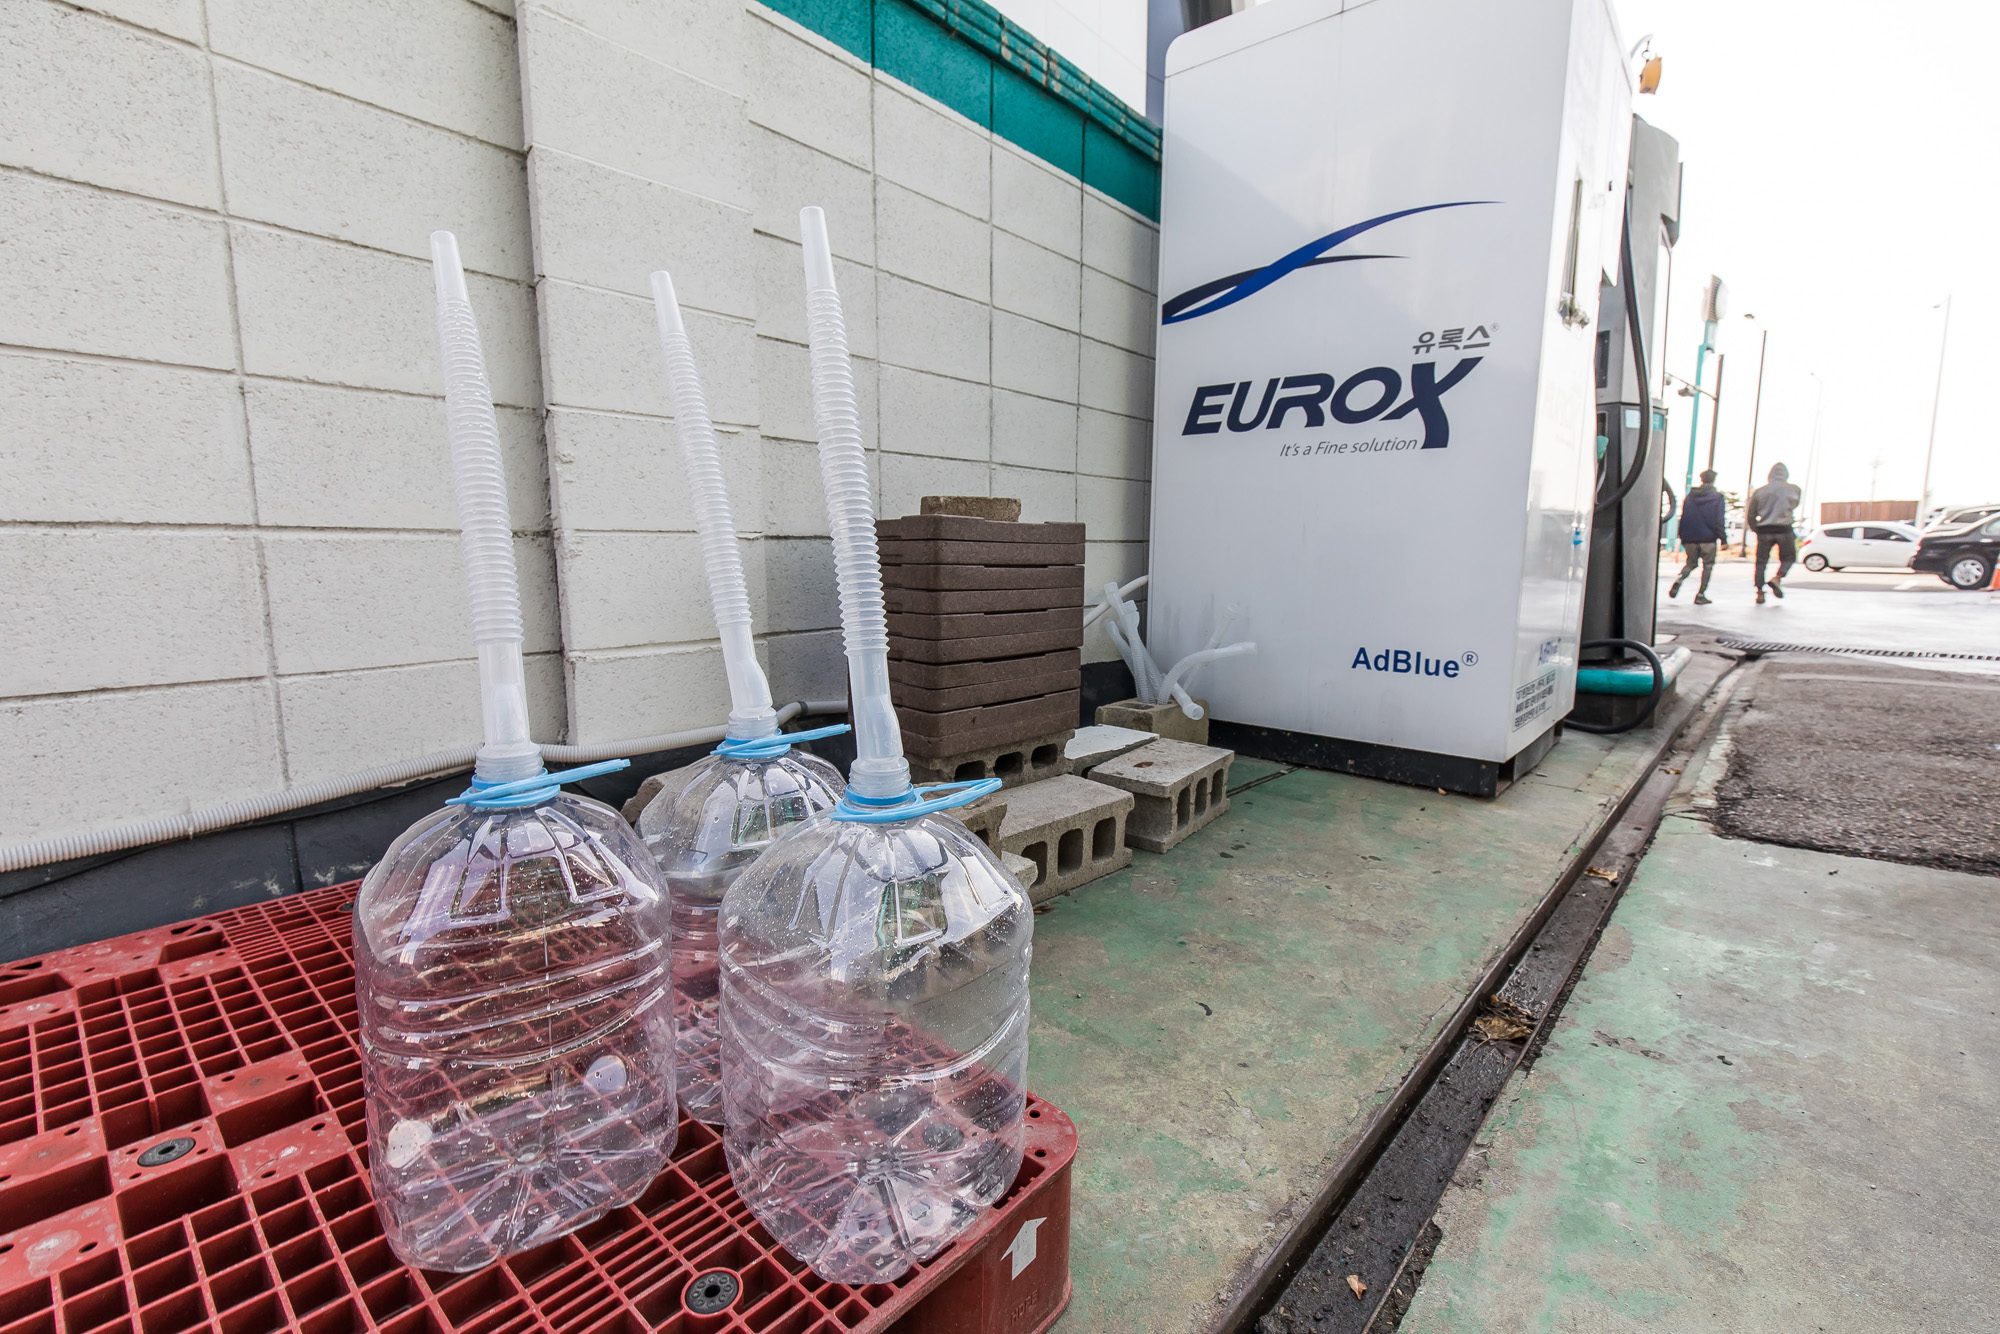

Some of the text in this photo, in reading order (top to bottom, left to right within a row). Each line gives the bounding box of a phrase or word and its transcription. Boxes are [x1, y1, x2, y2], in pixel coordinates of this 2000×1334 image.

[1181, 355, 1484, 449] EUROX
[1302, 444, 1312, 456] a
[1315, 441, 1348, 455] Fine
[1350, 437, 1418, 454] solution
